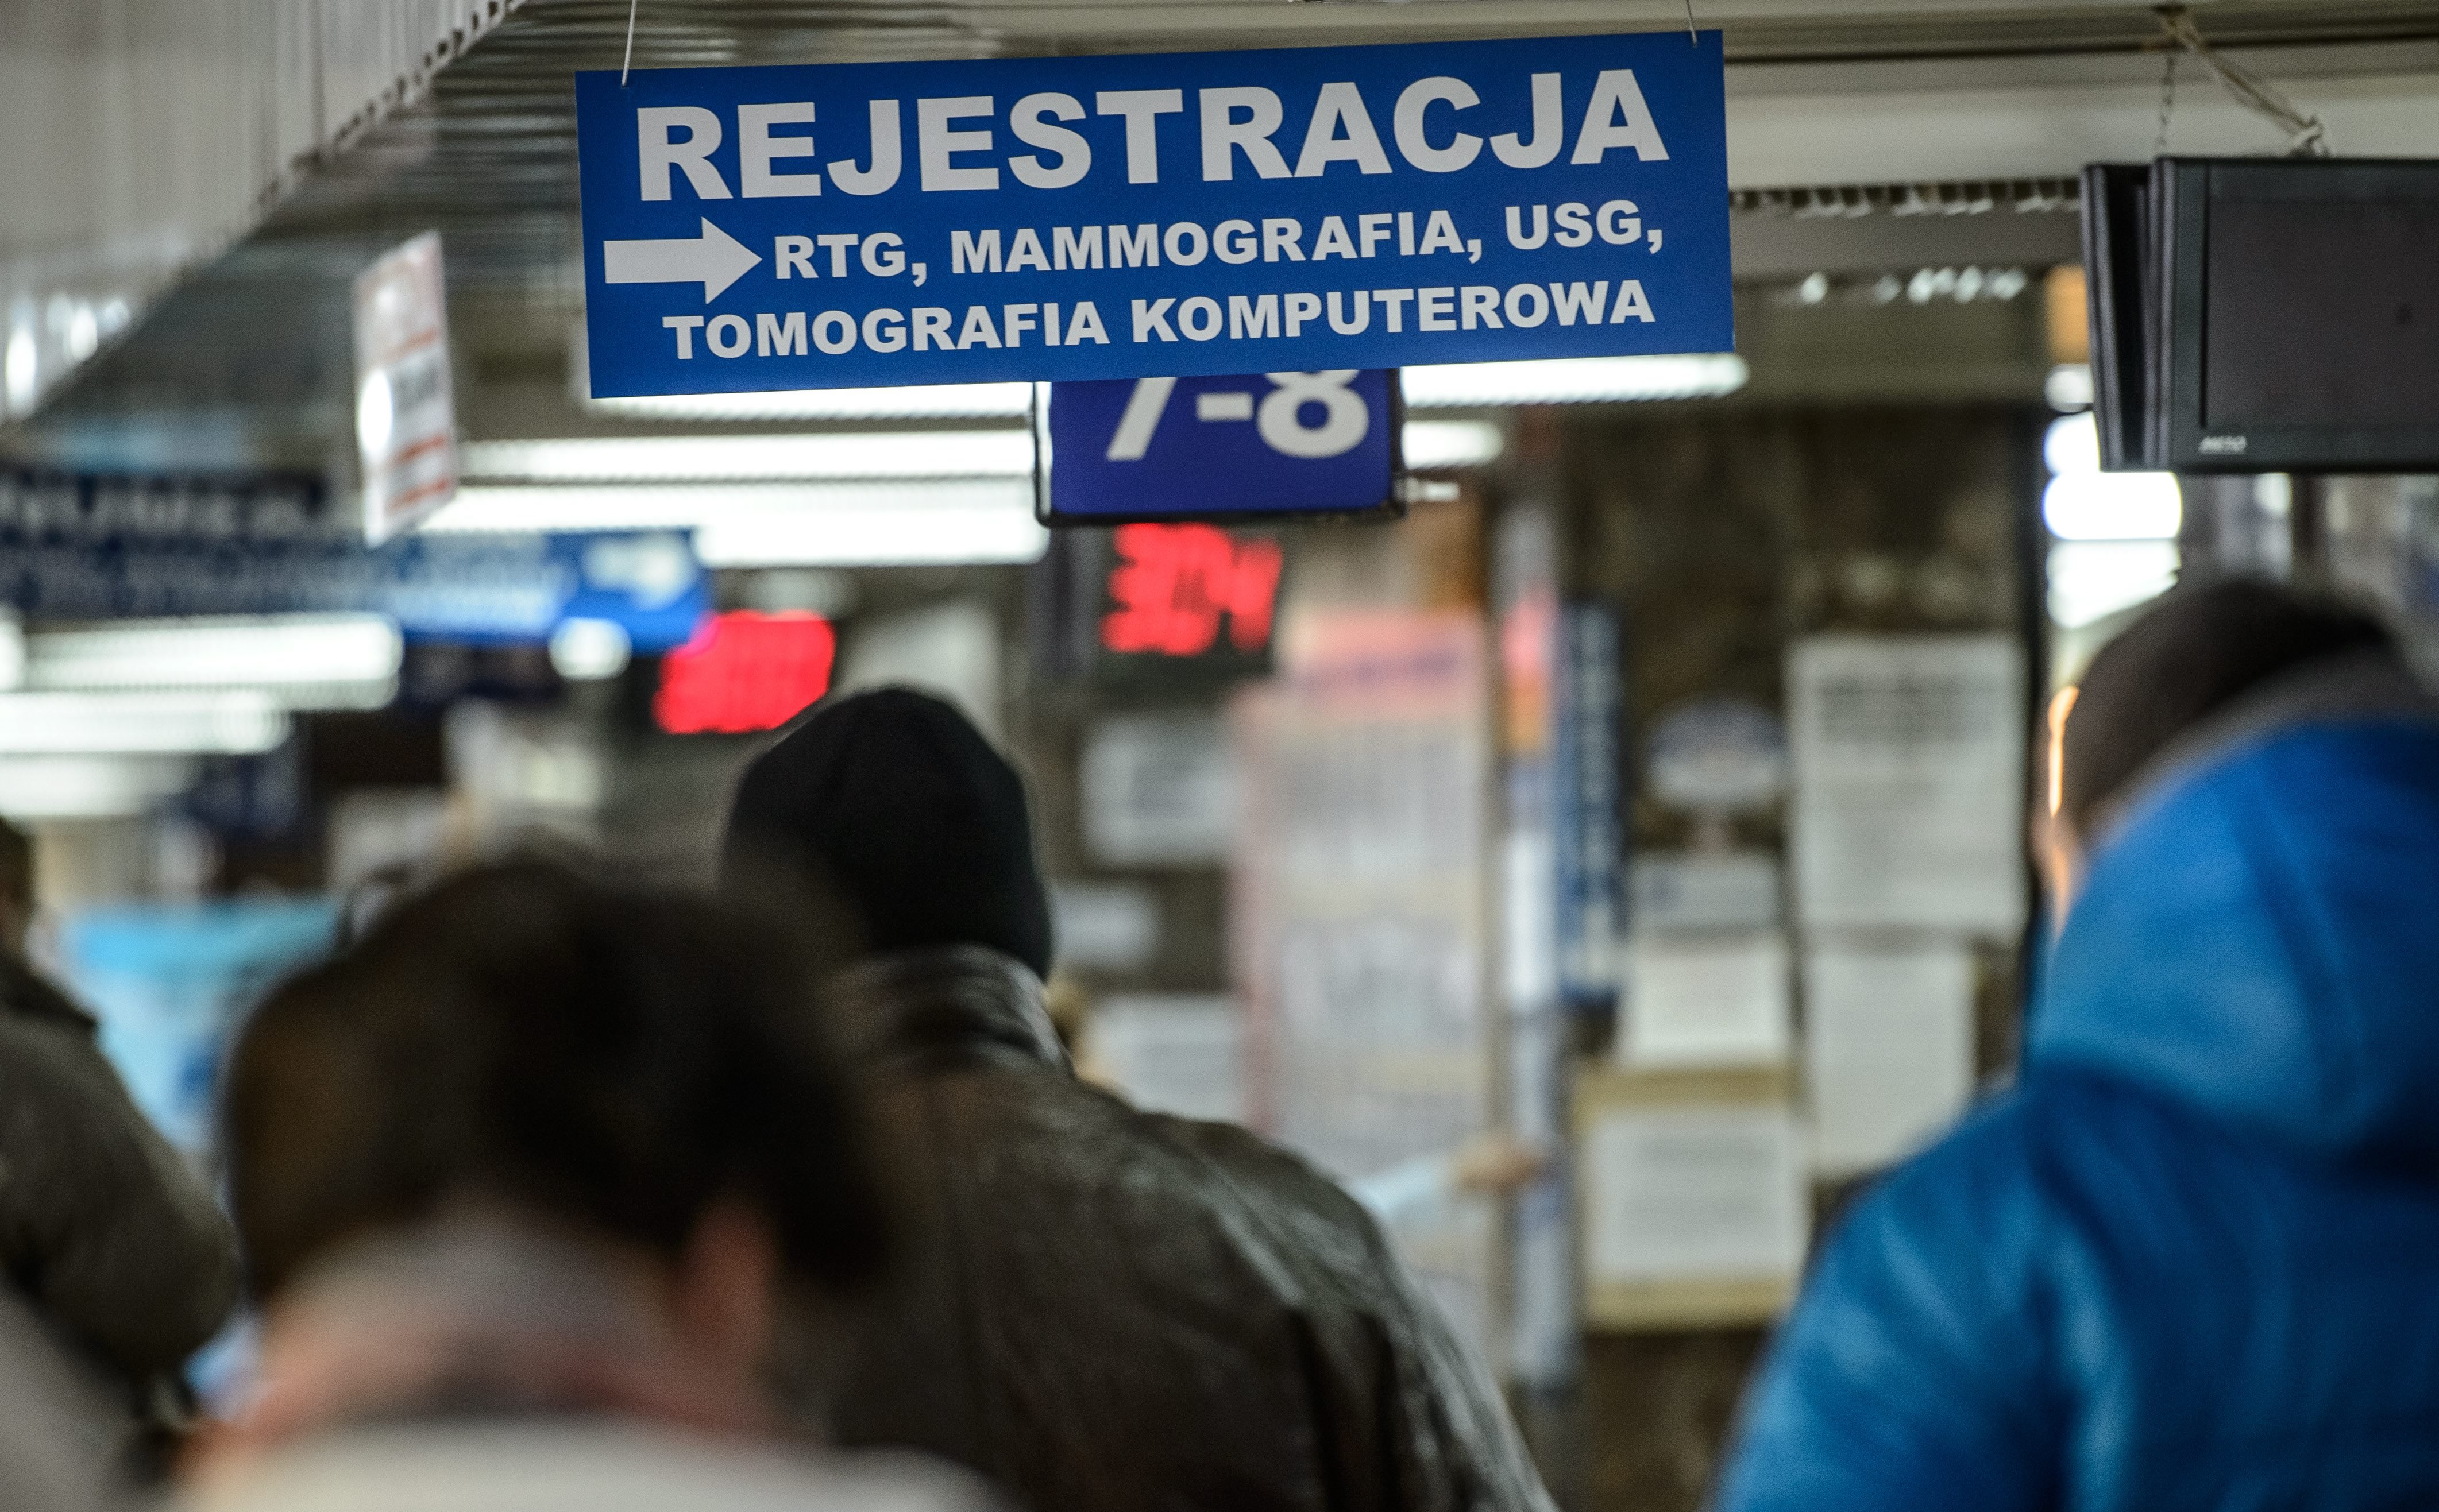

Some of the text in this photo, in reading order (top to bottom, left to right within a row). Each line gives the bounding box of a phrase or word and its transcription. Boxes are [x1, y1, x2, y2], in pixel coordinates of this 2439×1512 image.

[638, 70, 1669, 200] REJESTRACJA
[775, 200, 1662, 287] RTG, MAMMOGRAFIA, USG,
[663, 280, 1655, 359] TOMOGRAFIA KOMPUTEROWA
